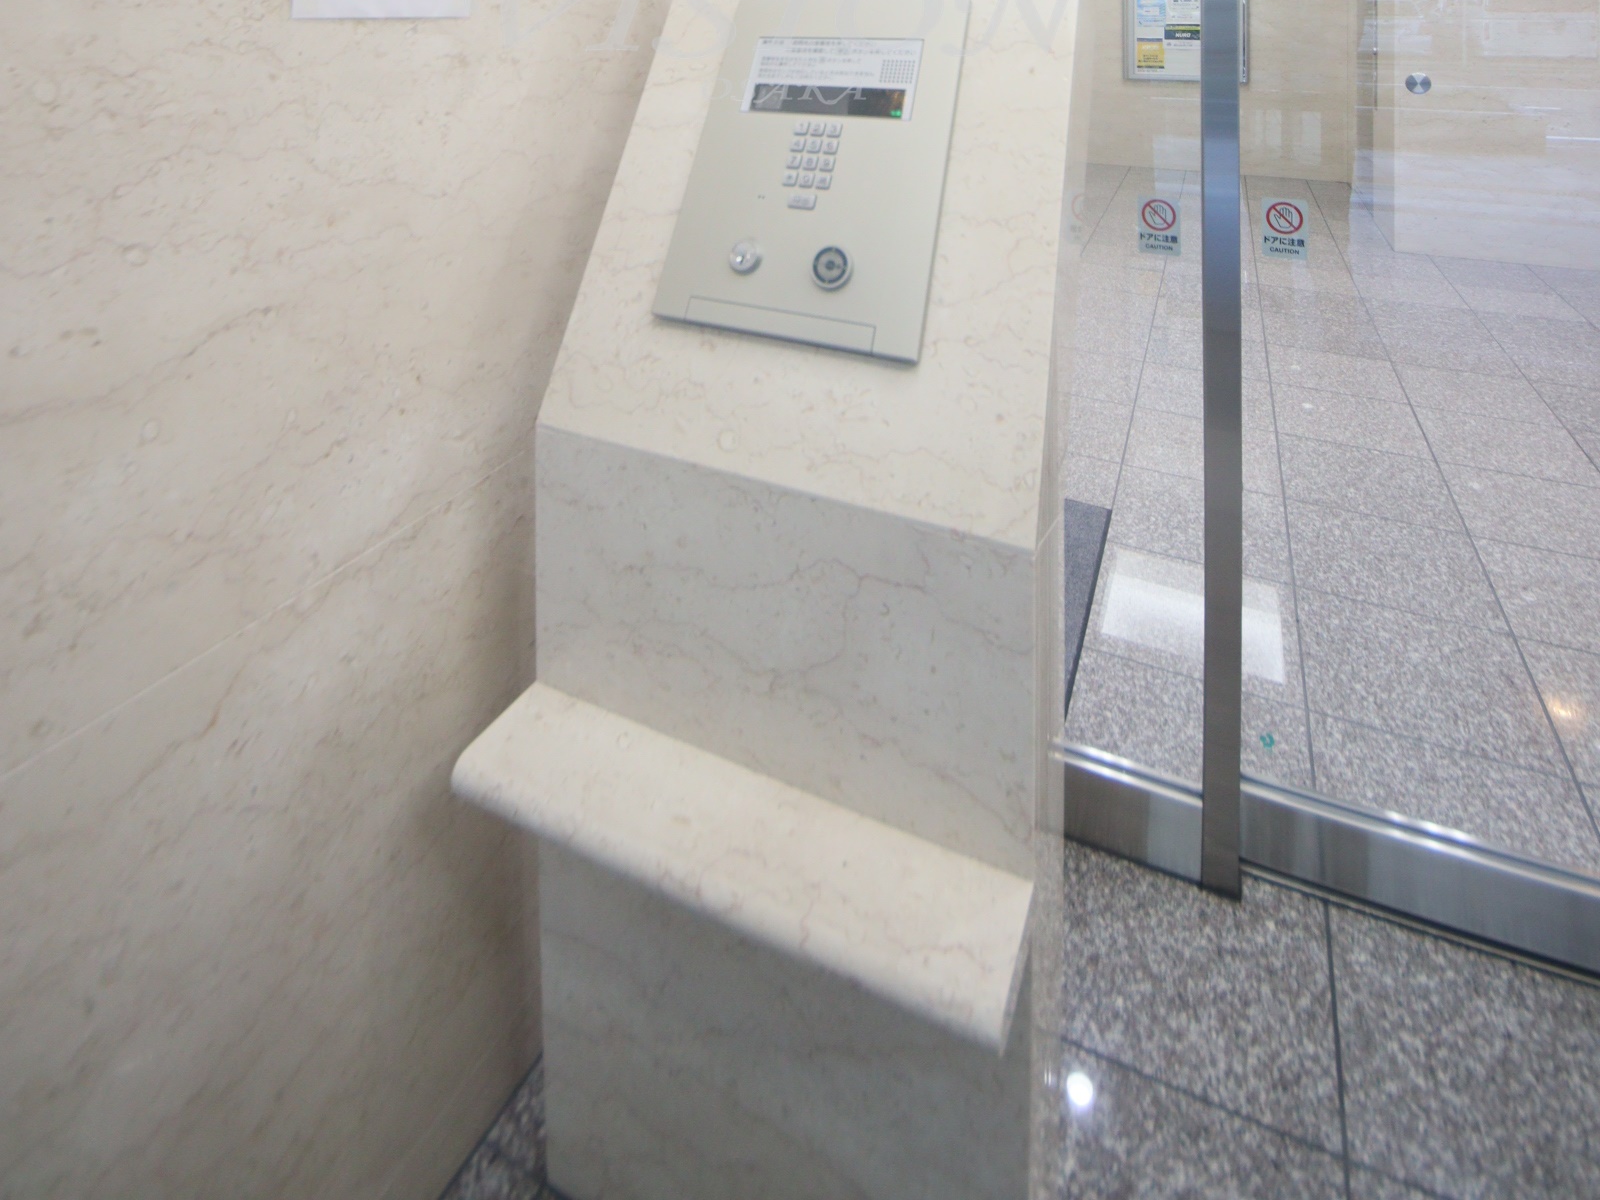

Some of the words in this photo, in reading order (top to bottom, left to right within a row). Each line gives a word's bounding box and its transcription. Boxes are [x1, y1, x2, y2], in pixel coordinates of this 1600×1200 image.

[1139, 232, 1178, 244] ドアに注意
[1263, 235, 1305, 247] ドアに注意
[1145, 243, 1173, 251] CAUTION
[1269, 246, 1300, 255] CAUTION
